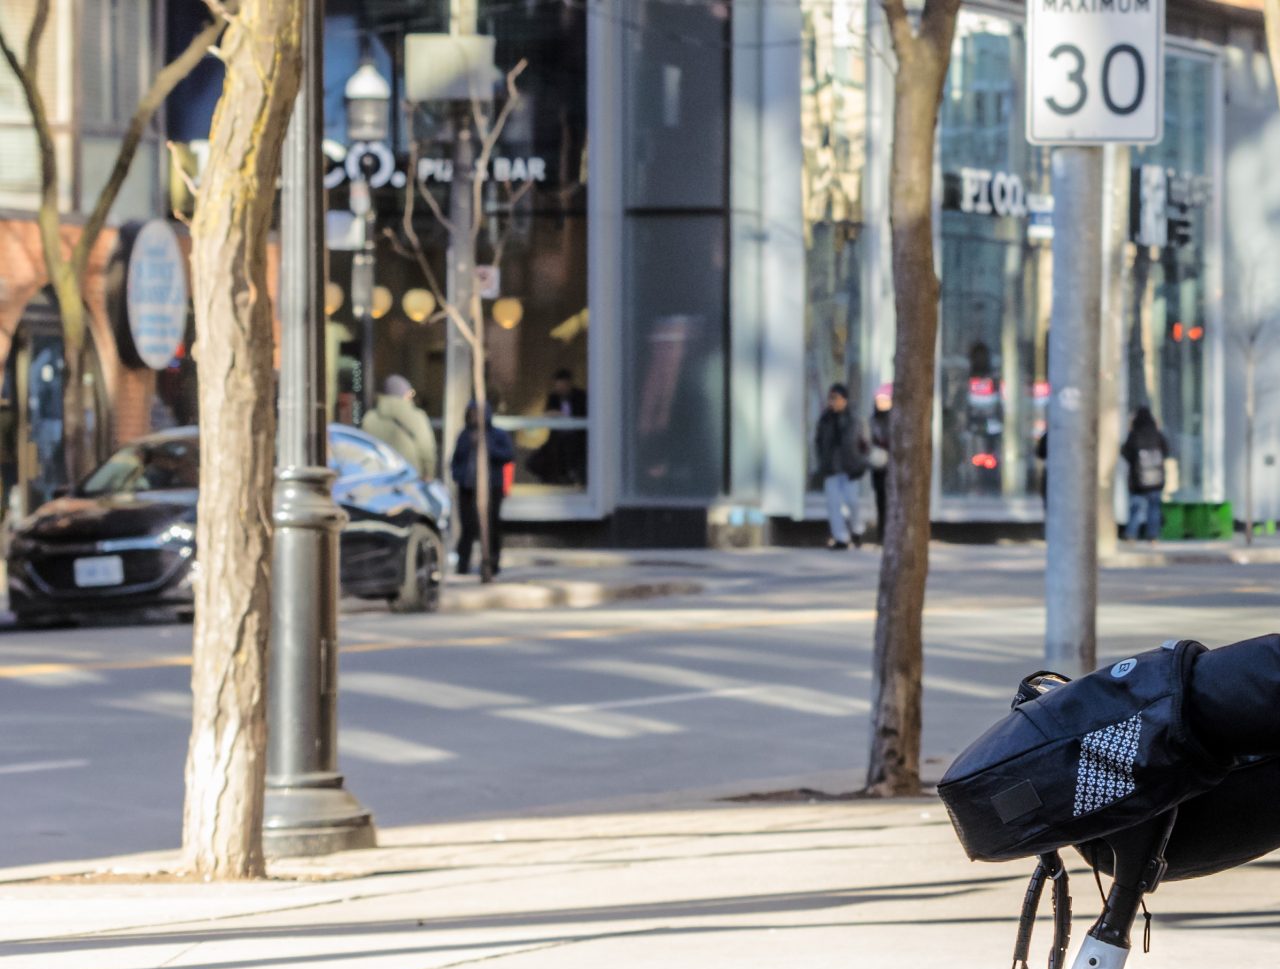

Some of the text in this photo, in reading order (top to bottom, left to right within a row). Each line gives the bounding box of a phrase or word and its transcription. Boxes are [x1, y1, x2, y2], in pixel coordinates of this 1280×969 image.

[1042, 0, 1150, 13] MAXIMUM
[1044, 43, 1145, 117] 30
[493, 157, 546, 182] BAR
[961, 167, 992, 214] PI
